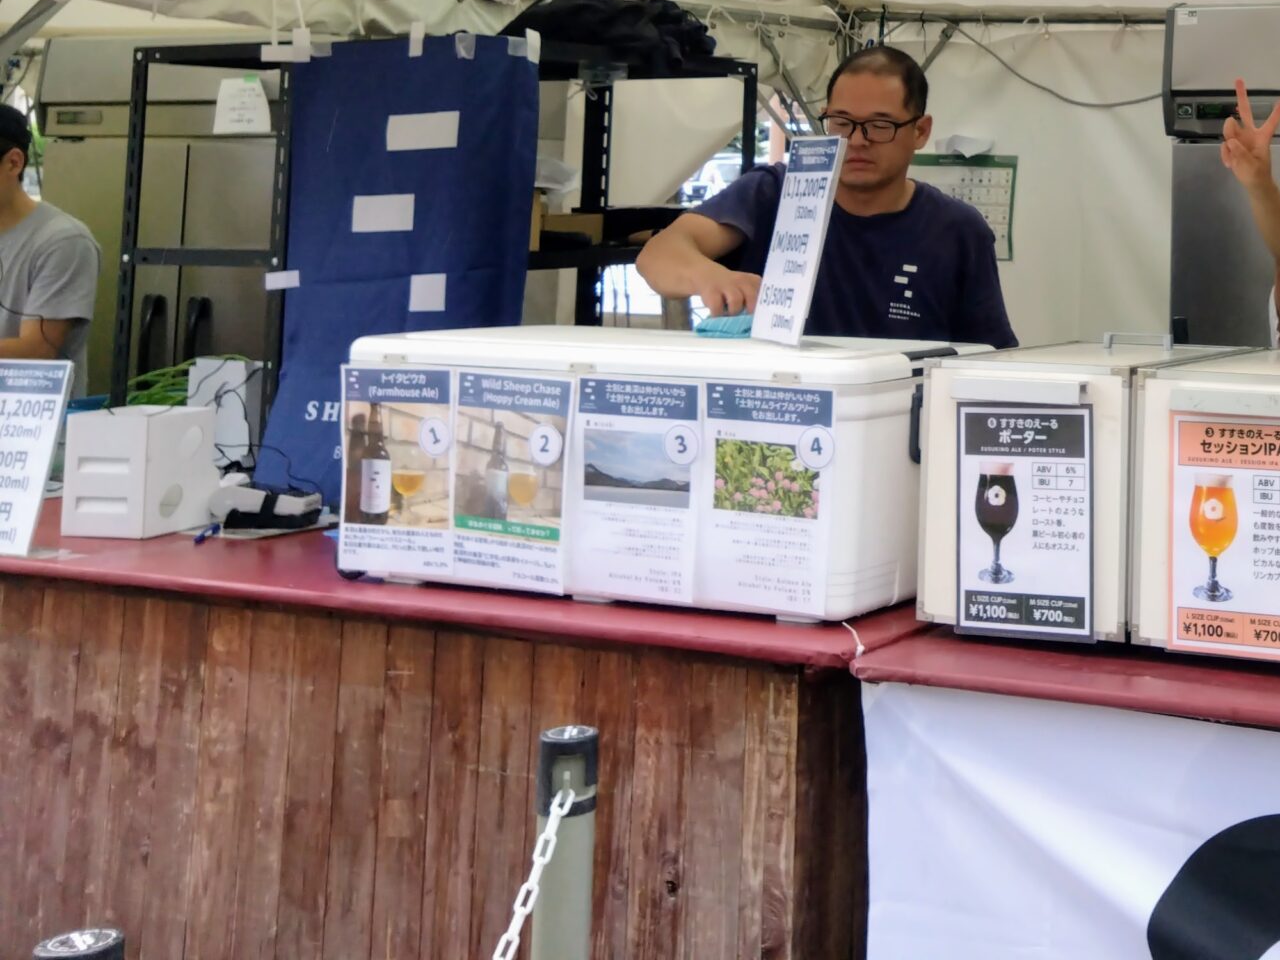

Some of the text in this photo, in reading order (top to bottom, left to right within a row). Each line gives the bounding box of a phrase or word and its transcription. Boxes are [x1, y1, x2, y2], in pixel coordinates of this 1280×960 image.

[381, 373, 426, 383] トイタビウカ
[423, 388, 439, 399] Ale)
[482, 378, 561, 395] Wild Sheep Chase
[483, 393, 560, 409] (Hoppy Cream Ale)
[429, 428, 440, 444] 1
[540, 435, 549, 452] 2
[674, 435, 687, 453] 3
[999, 431, 1047, 444] ポーター
[810, 437, 823, 456] 4
